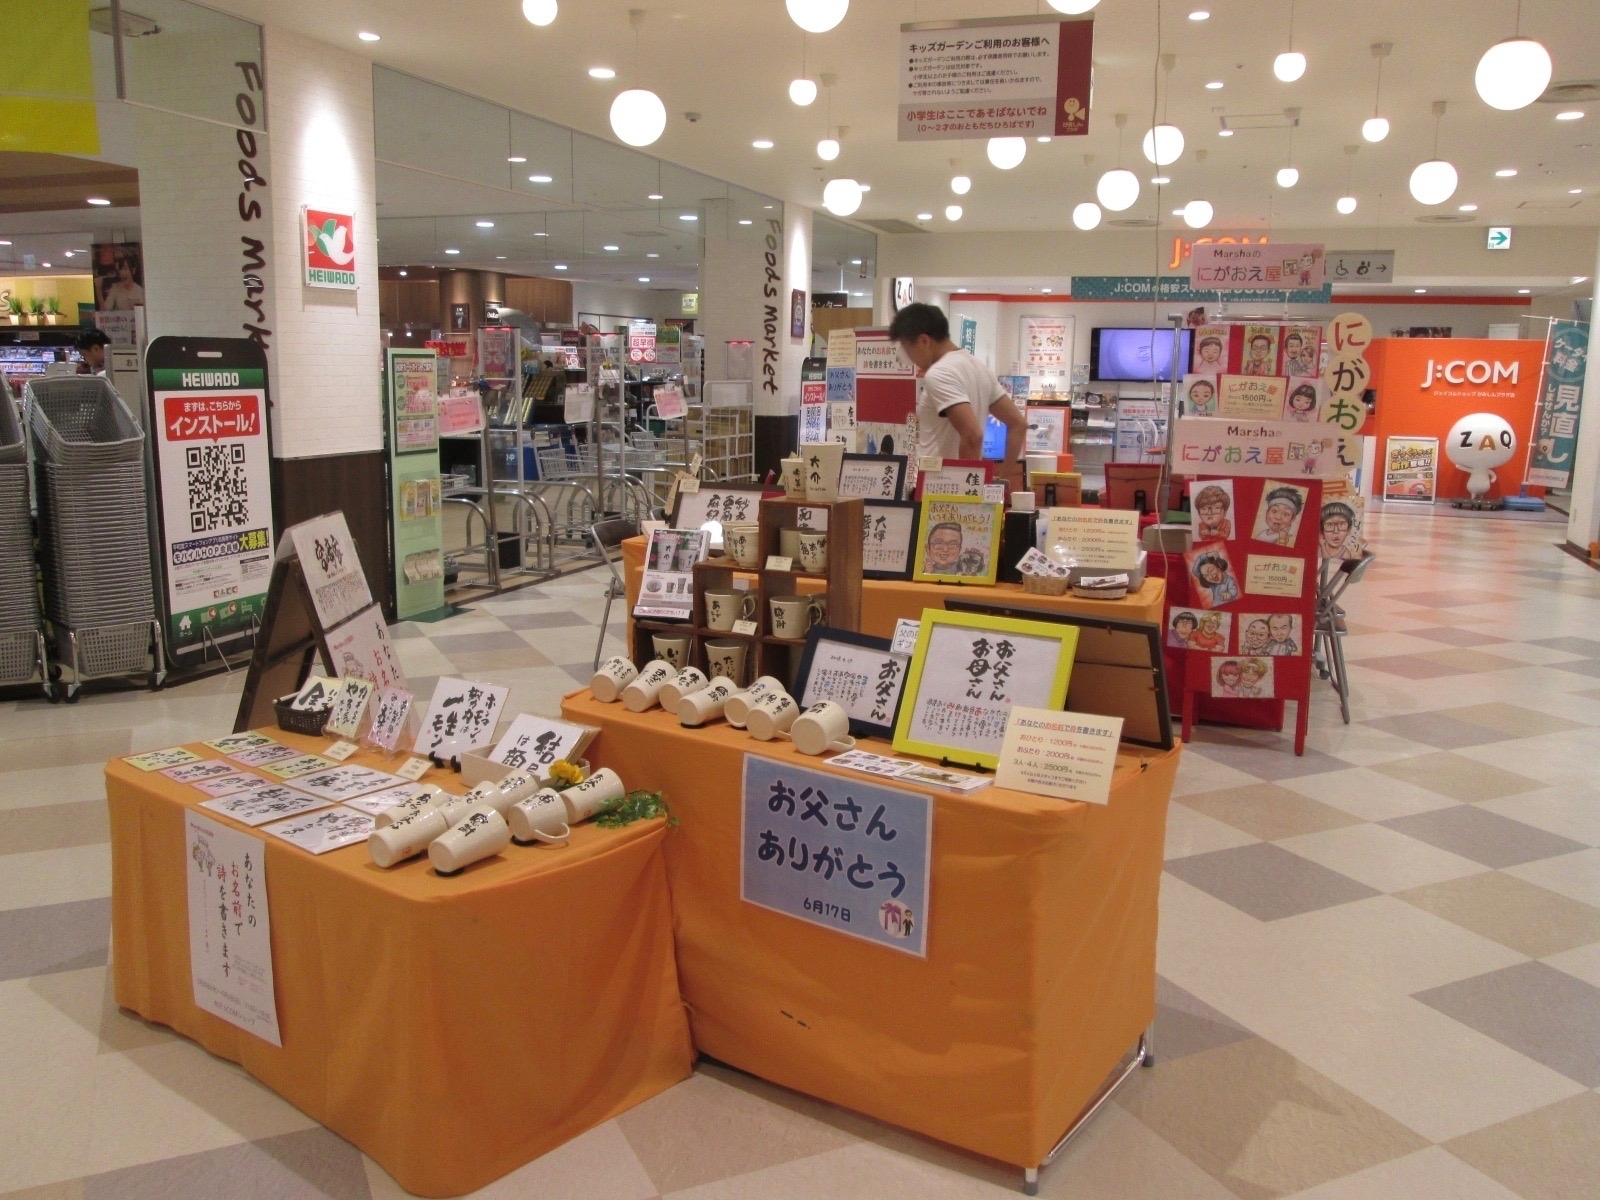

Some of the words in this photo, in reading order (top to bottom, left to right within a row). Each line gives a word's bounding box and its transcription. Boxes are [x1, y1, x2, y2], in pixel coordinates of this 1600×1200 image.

[909, 36, 1050, 53] キッズガーデンご利用のお客様へ
[907, 106, 1047, 121] 小学生はここであそばないでね
[764, 219, 782, 299] Foods
[309, 269, 356, 285] HEIWADO
[1197, 266, 1282, 282] にがおえ屋
[241, 235, 273, 350] Mark
[763, 305, 780, 395] Market
[1553, 351, 1579, 373] 料金
[182, 372, 239, 387] HEIWADO
[829, 383, 853, 391] ありがとう
[830, 370, 850, 379] お父さん
[1420, 360, 1519, 388] J:COM
[184, 400, 242, 412] まずは、こちらから
[1227, 426, 1283, 438] Marshaの
[1548, 384, 1580, 463] 見直し
[1460, 430, 1512, 451] ZAQ
[1182, 444, 1285, 466] にがおえ屋
[809, 455, 821, 484] 大介
[930, 503, 958, 514] お父さん
[966, 637, 994, 700] お母さん
[989, 639, 1016, 702] お父さん
[870, 658, 901, 722] お父さん
[768, 779, 897, 842] お父さん
[758, 829, 906, 899] ありがとう
[230, 861, 244, 936] お名前で
[244, 852, 257, 928] あなたの
[216, 863, 231, 978] 詩を書きます
[803, 897, 851, 923] 6月17日
